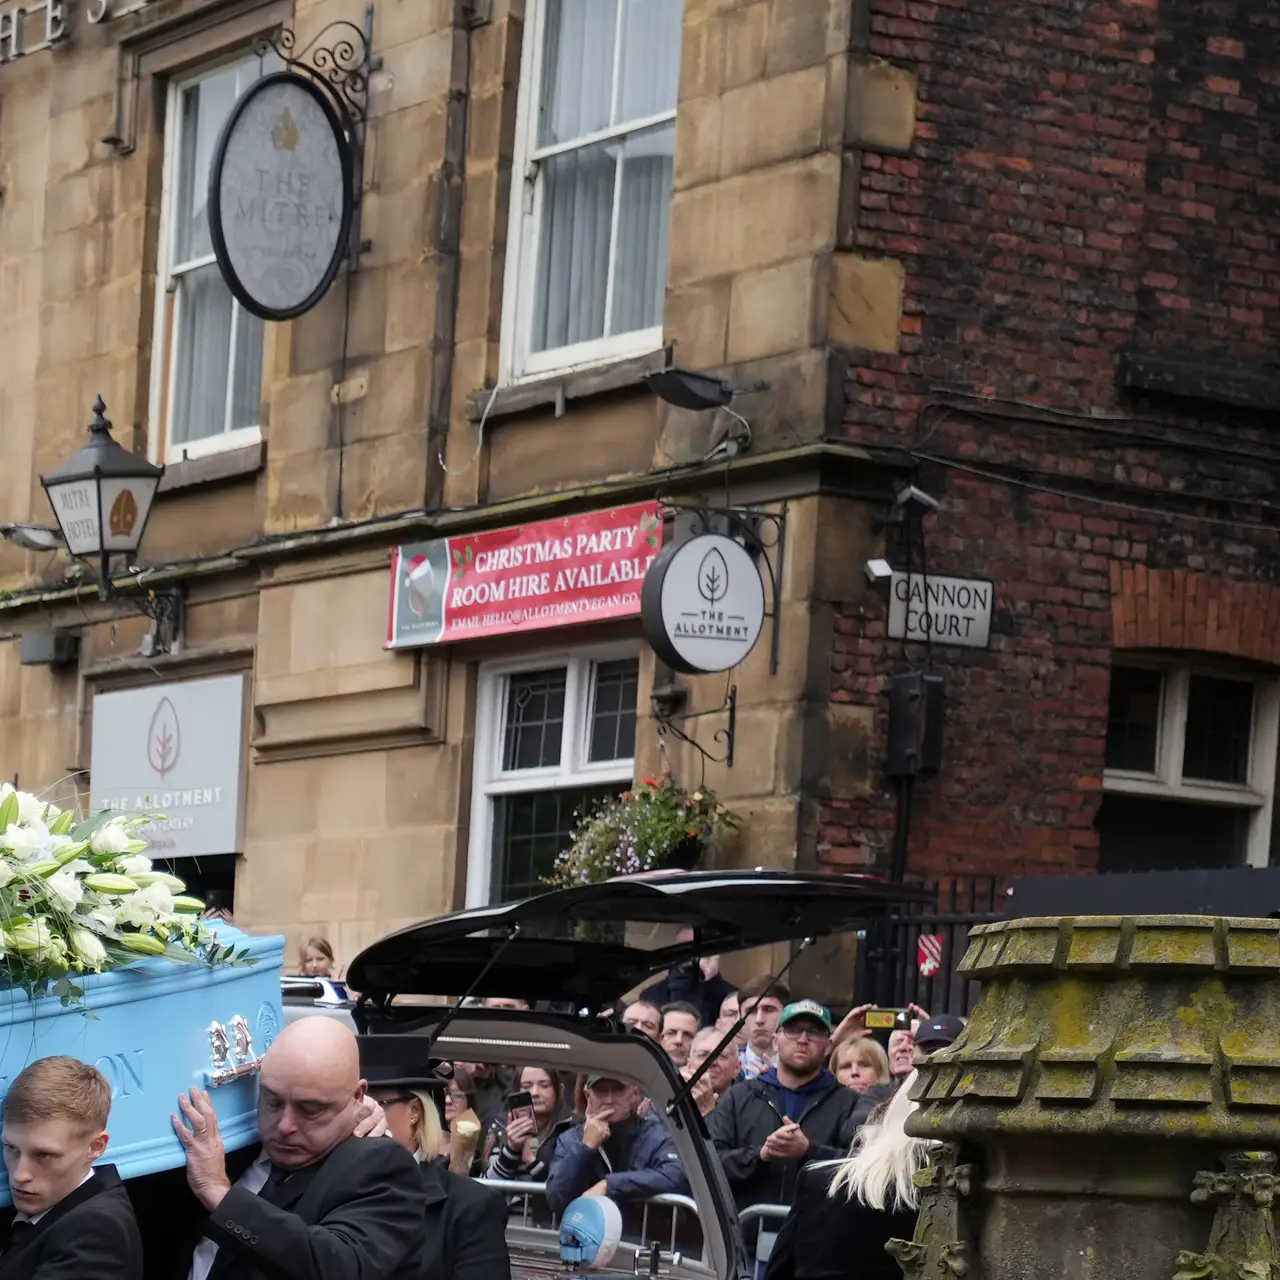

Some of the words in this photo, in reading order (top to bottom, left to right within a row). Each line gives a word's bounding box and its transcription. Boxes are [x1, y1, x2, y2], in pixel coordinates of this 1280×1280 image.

[66, 518, 97, 541] HOTEL
[474, 538, 573, 574] CHRISTMAS
[577, 525, 638, 556] PARTY
[451, 579, 507, 608] ROOM
[508, 571, 550, 599] HIRE
[451, 616, 481, 631] EMAIL
[701, 611, 724, 621] THE
[907, 610, 976, 637] COURT
[675, 623, 748, 636] ALLOTMENT
[102, 797, 130, 811] THE
